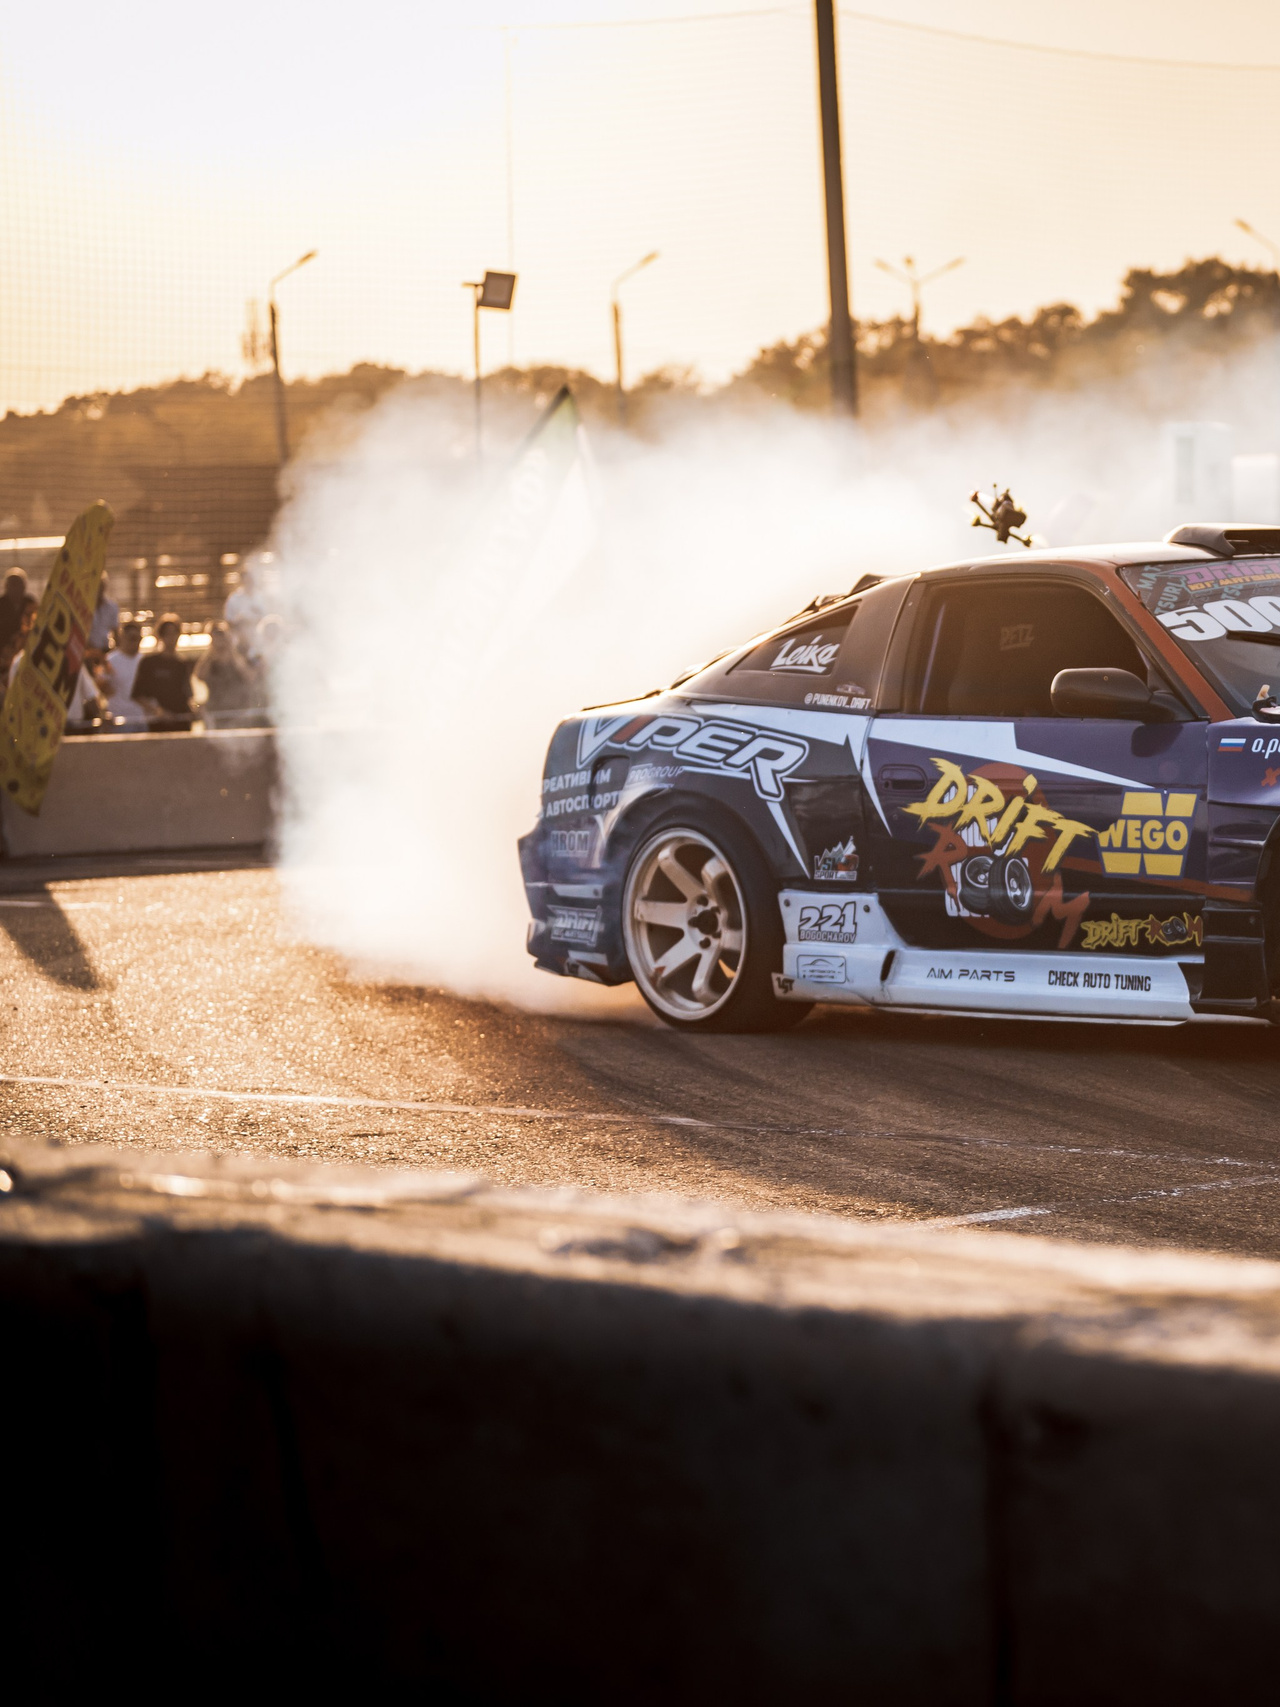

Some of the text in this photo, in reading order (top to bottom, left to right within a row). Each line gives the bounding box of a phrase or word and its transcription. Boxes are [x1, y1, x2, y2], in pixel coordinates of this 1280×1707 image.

[576, 713, 809, 802] VIPER
[902, 758, 1102, 874] DRIFT
[1098, 819, 1188, 850] WEGO
[799, 901, 857, 934] 221
[800, 929, 856, 943] BOGOCHAROV
[927, 967, 1015, 982] AIM PARTS
[1048, 970, 1152, 992] CHECK AUTO TUNING
